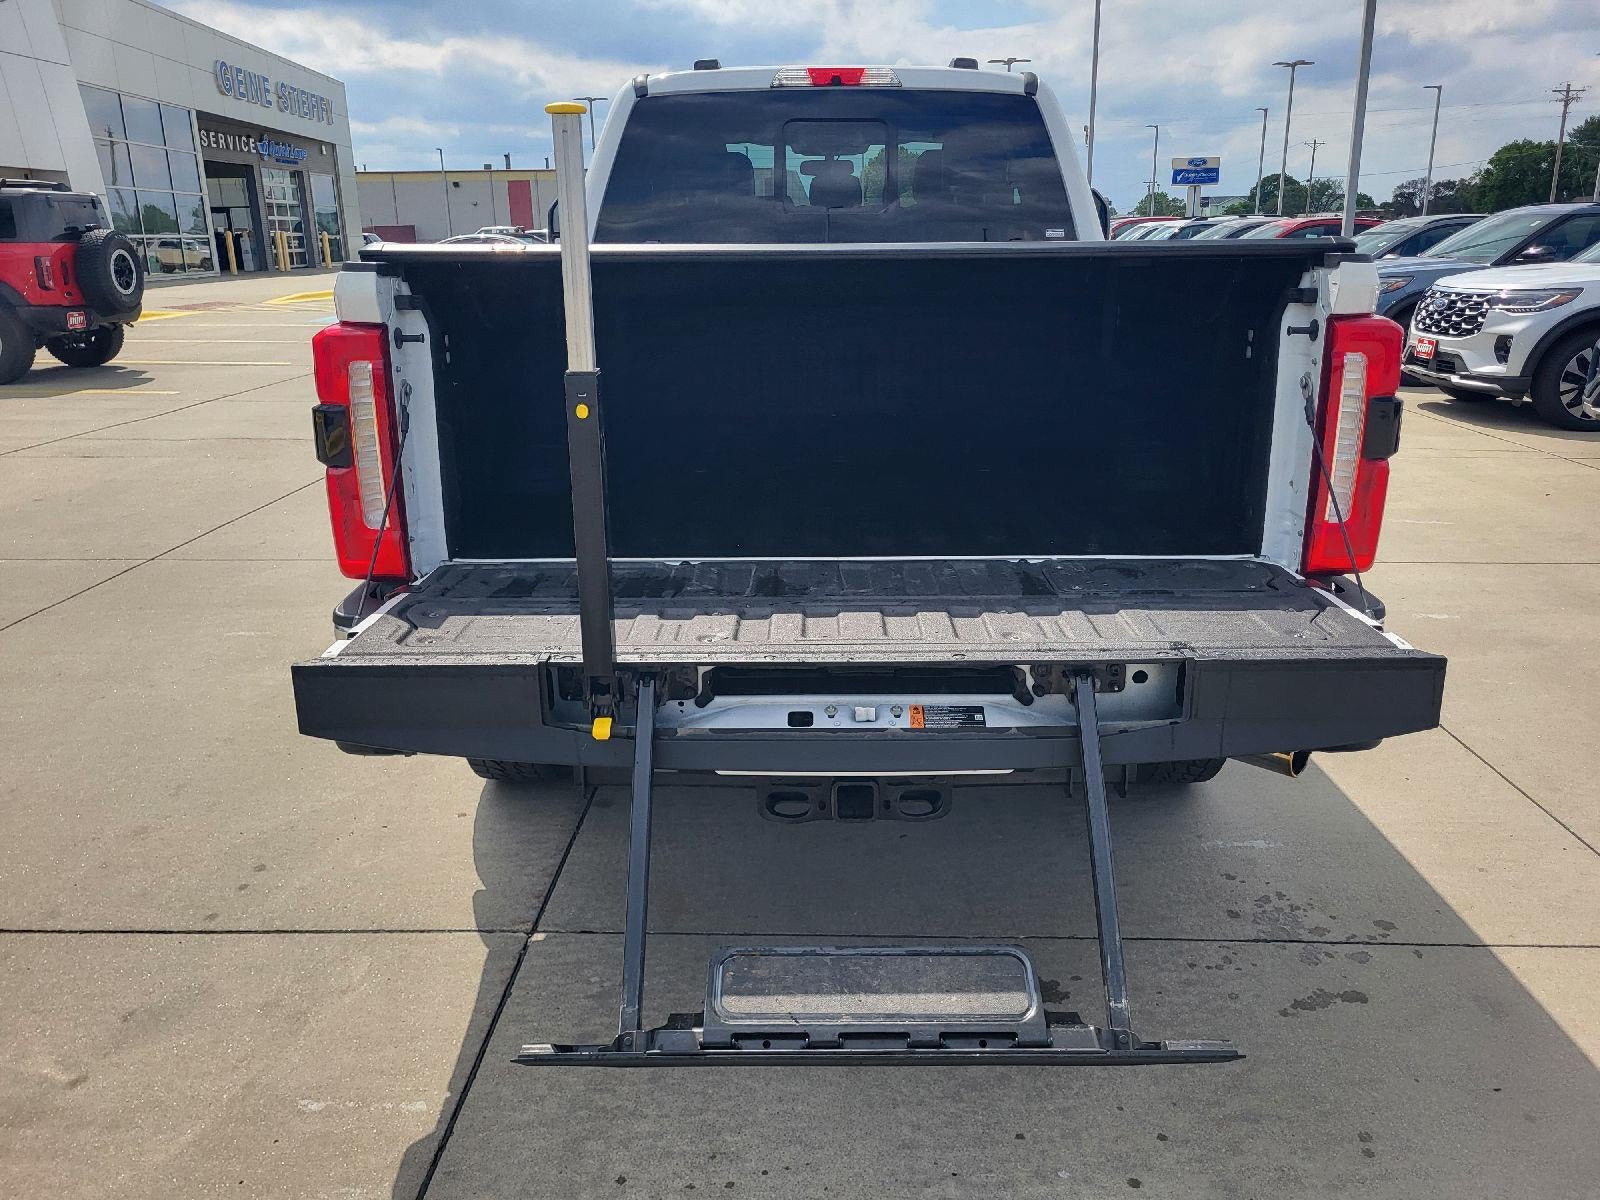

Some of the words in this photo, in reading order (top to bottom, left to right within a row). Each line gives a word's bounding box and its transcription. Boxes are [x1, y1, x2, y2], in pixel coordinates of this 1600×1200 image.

[216, 59, 273, 108] GENE
[276, 80, 334, 126] STEFFY
[200, 129, 257, 153] SERVICE
